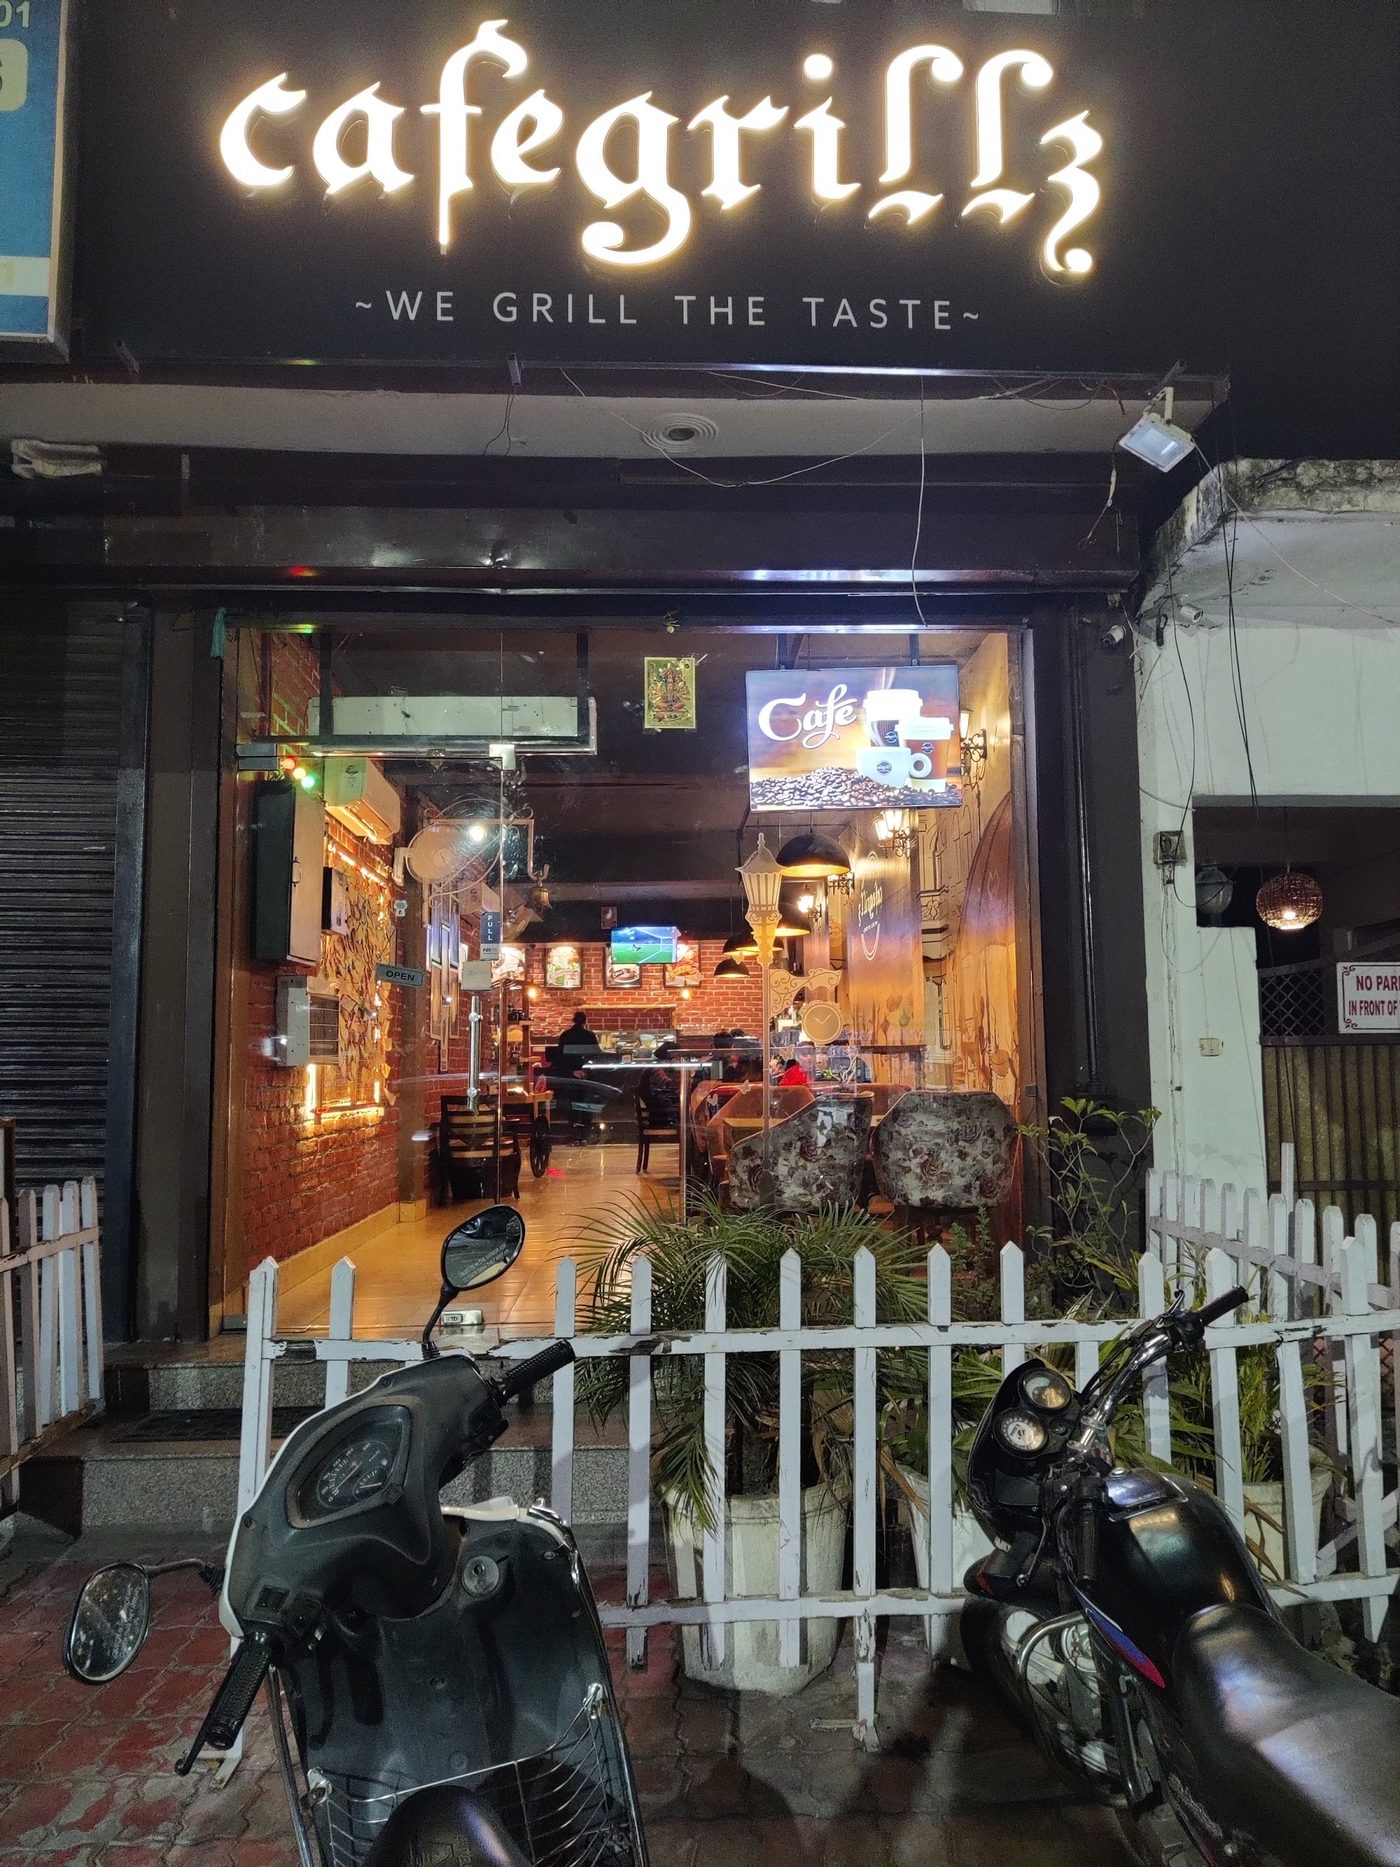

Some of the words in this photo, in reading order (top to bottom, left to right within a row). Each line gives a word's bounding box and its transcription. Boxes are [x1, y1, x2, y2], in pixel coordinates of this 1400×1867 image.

[492, 291, 638, 324] GRILL
[674, 295, 766, 326] THE
[758, 683, 858, 749] Cafe
[386, 970, 415, 982] OPEN
[1356, 975, 1373, 991] NO
[1376, 975, 1400, 991] PAR
[1348, 1000, 1357, 1016] IN
[1359, 1000, 1385, 1016] FRONT
[1387, 1000, 1398, 1016] OF
